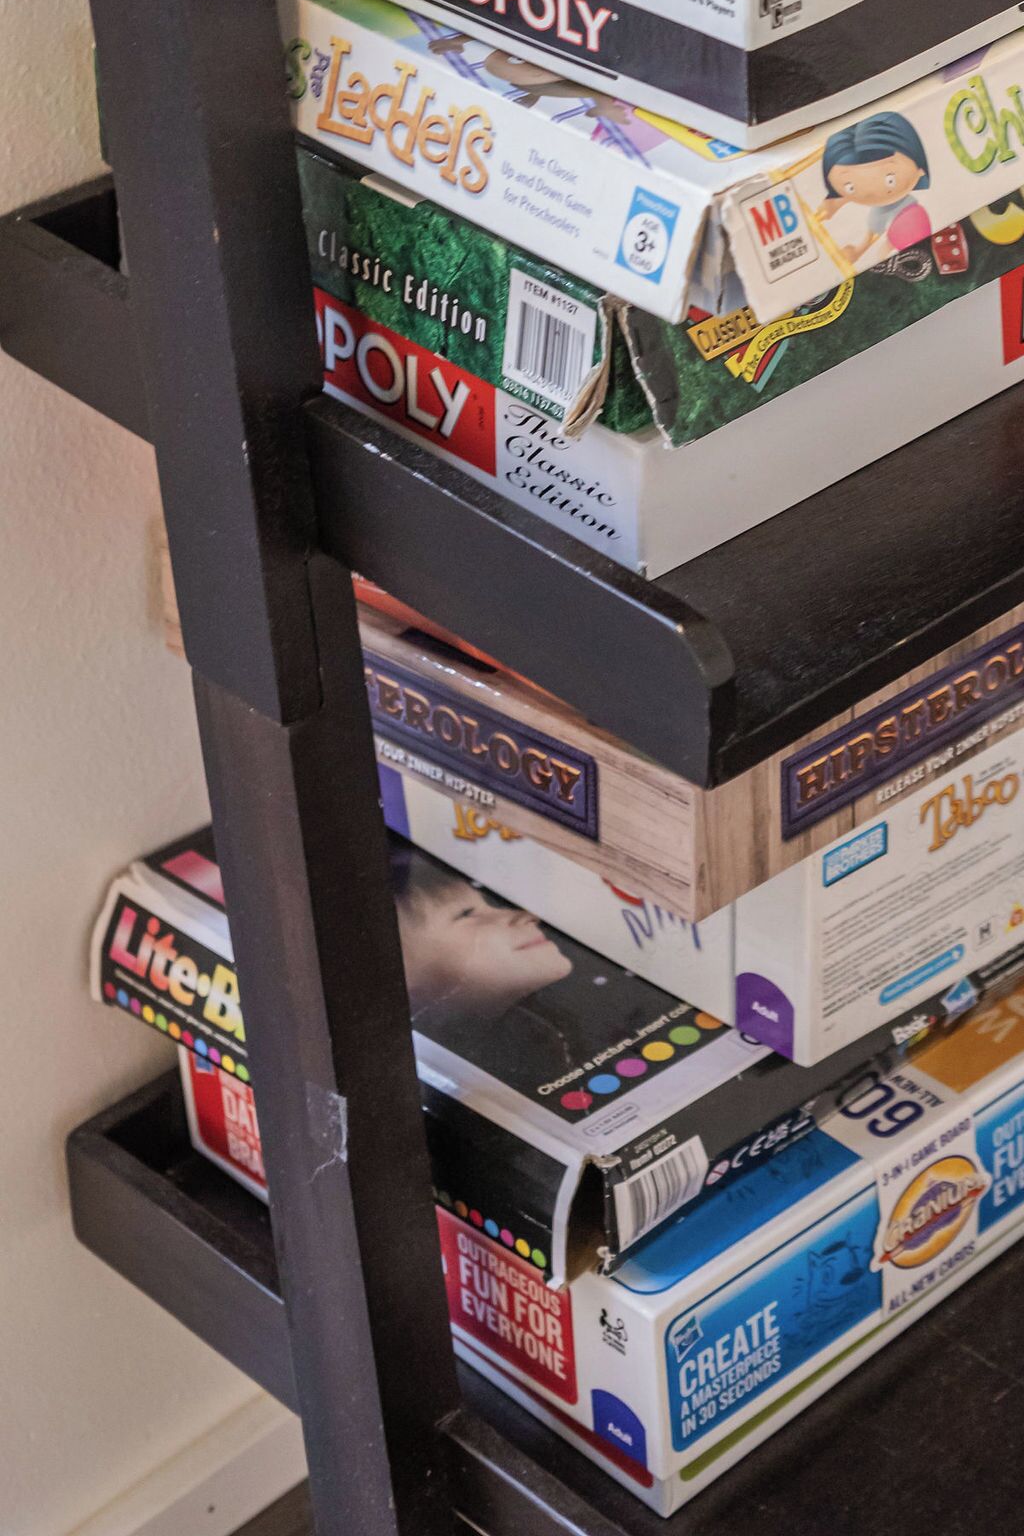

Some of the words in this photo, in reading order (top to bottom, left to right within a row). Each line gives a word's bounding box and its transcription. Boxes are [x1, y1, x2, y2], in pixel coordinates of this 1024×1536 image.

[316, 36, 494, 194] Ladders
[501, 160, 516, 180] Up
[515, 172, 535, 189] and
[535, 177, 564, 205] Down
[564, 193, 594, 219] Game
[527, 148, 546, 169] The
[547, 159, 579, 185] Classic
[503, 186, 520, 205] for
[519, 195, 582, 239] Preschoolers
[633, 230, 656, 253] 3+
[750, 192, 801, 248] MB
[768, 235, 804, 258] MILTON
[769, 244, 810, 271] BRADLEY
[317, 229, 394, 294] Classic
[403, 273, 488, 345] Edition
[523, 279, 550, 302] ITEM
[316, 305, 471, 440] POLY
[503, 401, 574, 452] The
[504, 434, 618, 508] Classic
[504, 465, 622, 543] Edition
[443, 768, 496, 807] HIPSTER
[876, 765, 927, 805] RELEASE
[925, 747, 956, 774] YOUR
[919, 773, 1020, 854] Taboo
[751, 1000, 780, 1023] Adult
[537, 1065, 585, 1096] Choose
[583, 1061, 595, 1071] a
[909, 1141, 939, 1168] GAME
[940, 1118, 973, 1148] BOARD
[456, 1231, 562, 1317] OUTRAGEOUS
[458, 1254, 510, 1314] FUN
[513, 1293, 565, 1353] FOR
[460, 1286, 568, 1382] EVERYONE
[678, 1300, 781, 1399] CREATE
[680, 1400, 691, 1420] A
[691, 1334, 782, 1413] MASTERPIECE
[681, 1413, 698, 1439] IN
[698, 1398, 718, 1426] 30
[717, 1354, 782, 1411] SECONDS
[607, 1422, 634, 1448] Adult
